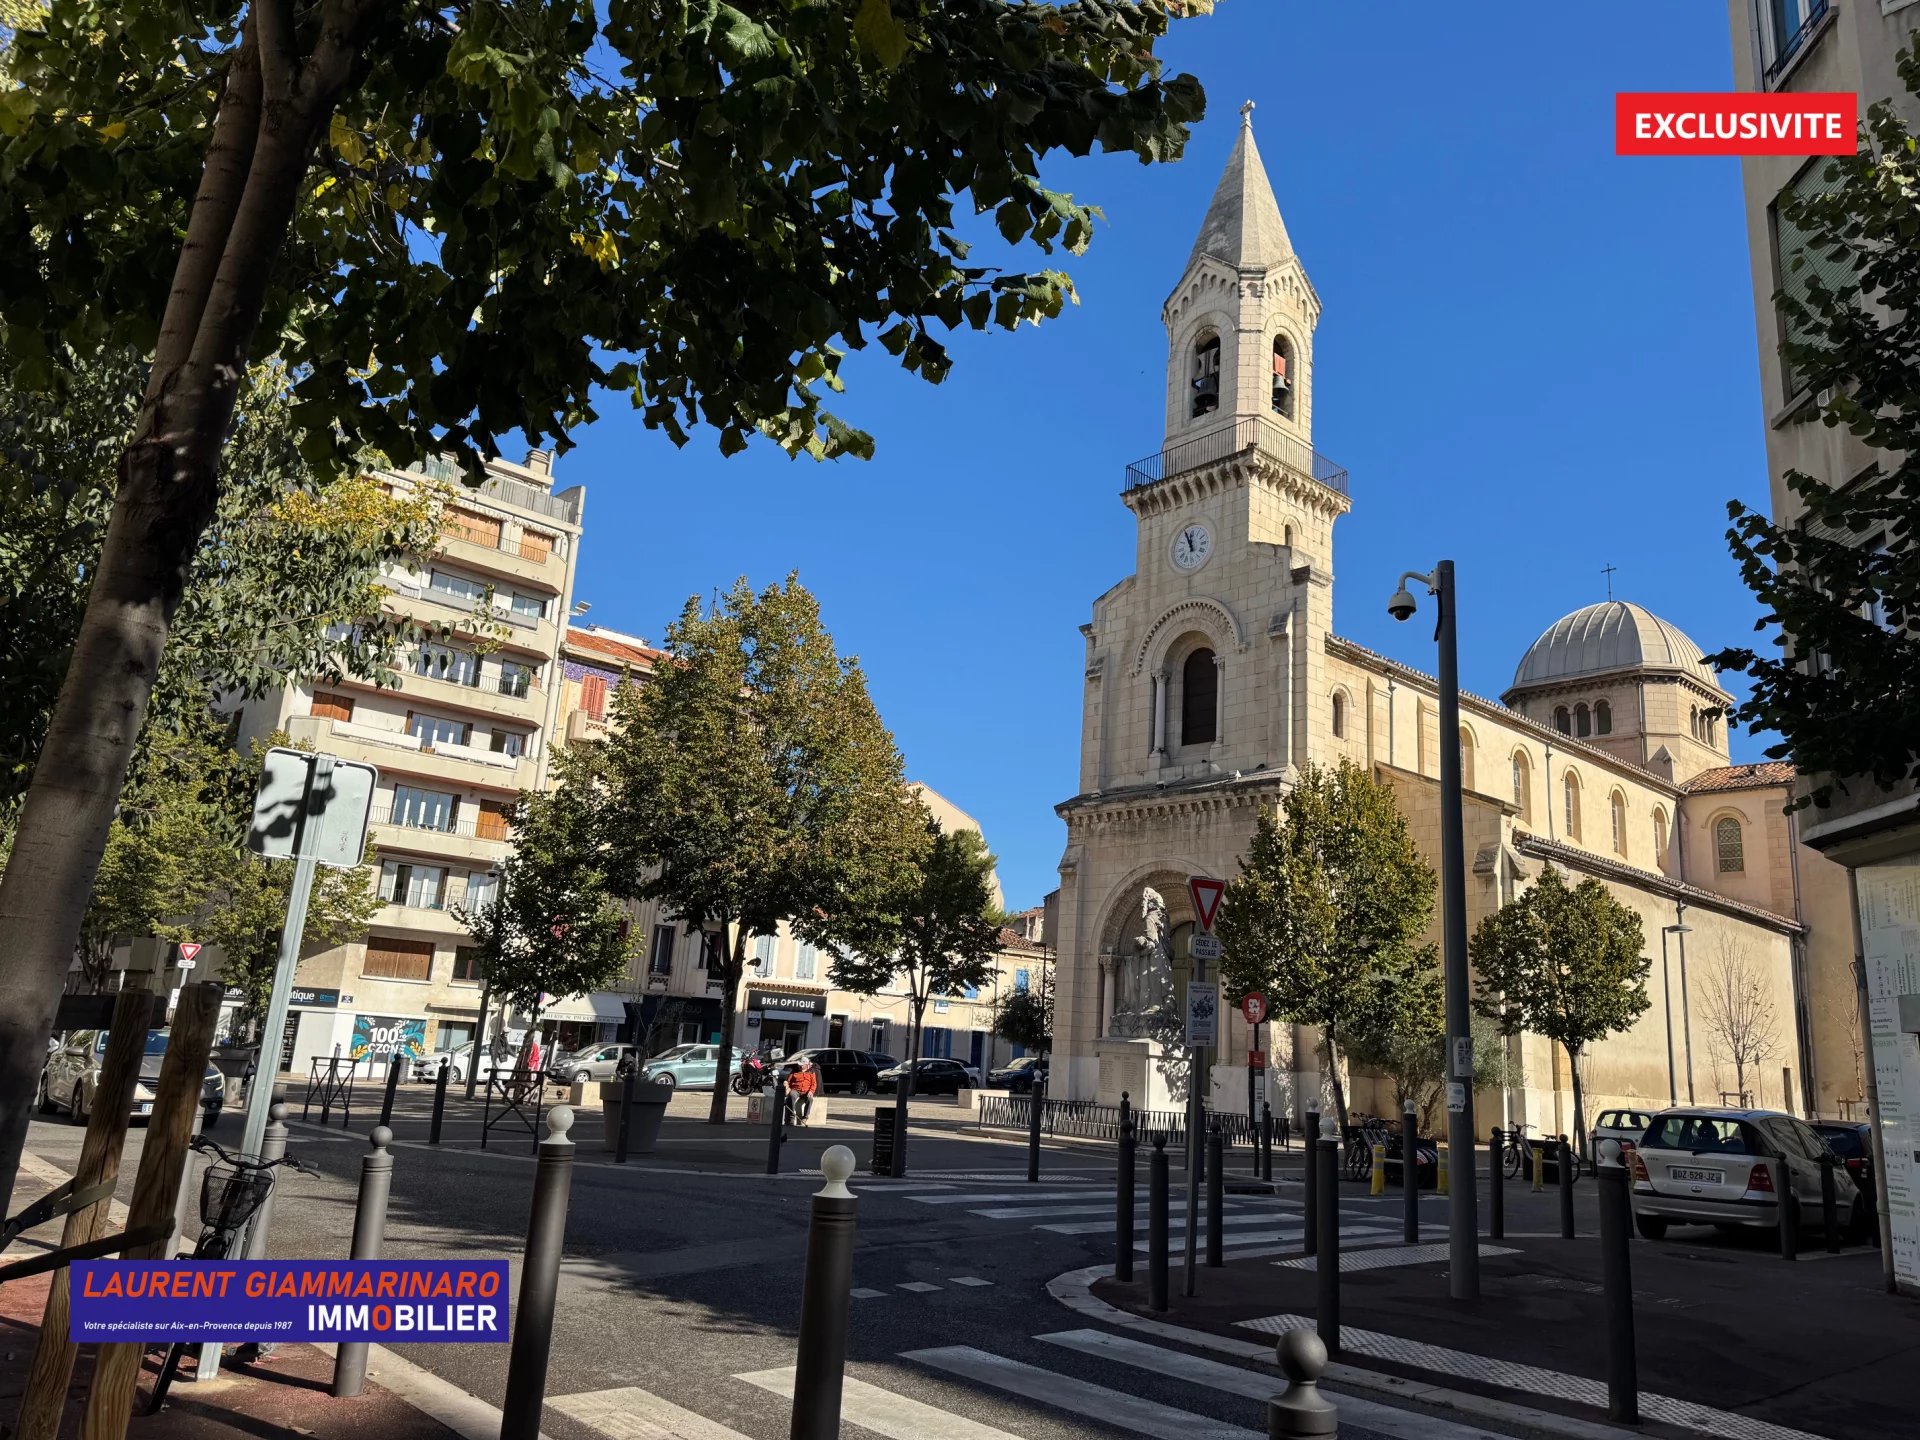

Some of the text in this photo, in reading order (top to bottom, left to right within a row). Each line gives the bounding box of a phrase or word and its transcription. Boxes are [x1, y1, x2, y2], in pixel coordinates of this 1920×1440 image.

[1211, 940, 1217, 948] LE
[1195, 948, 1217, 957] PASSAGE
[761, 996, 816, 1009] BKH OPTIQUE
